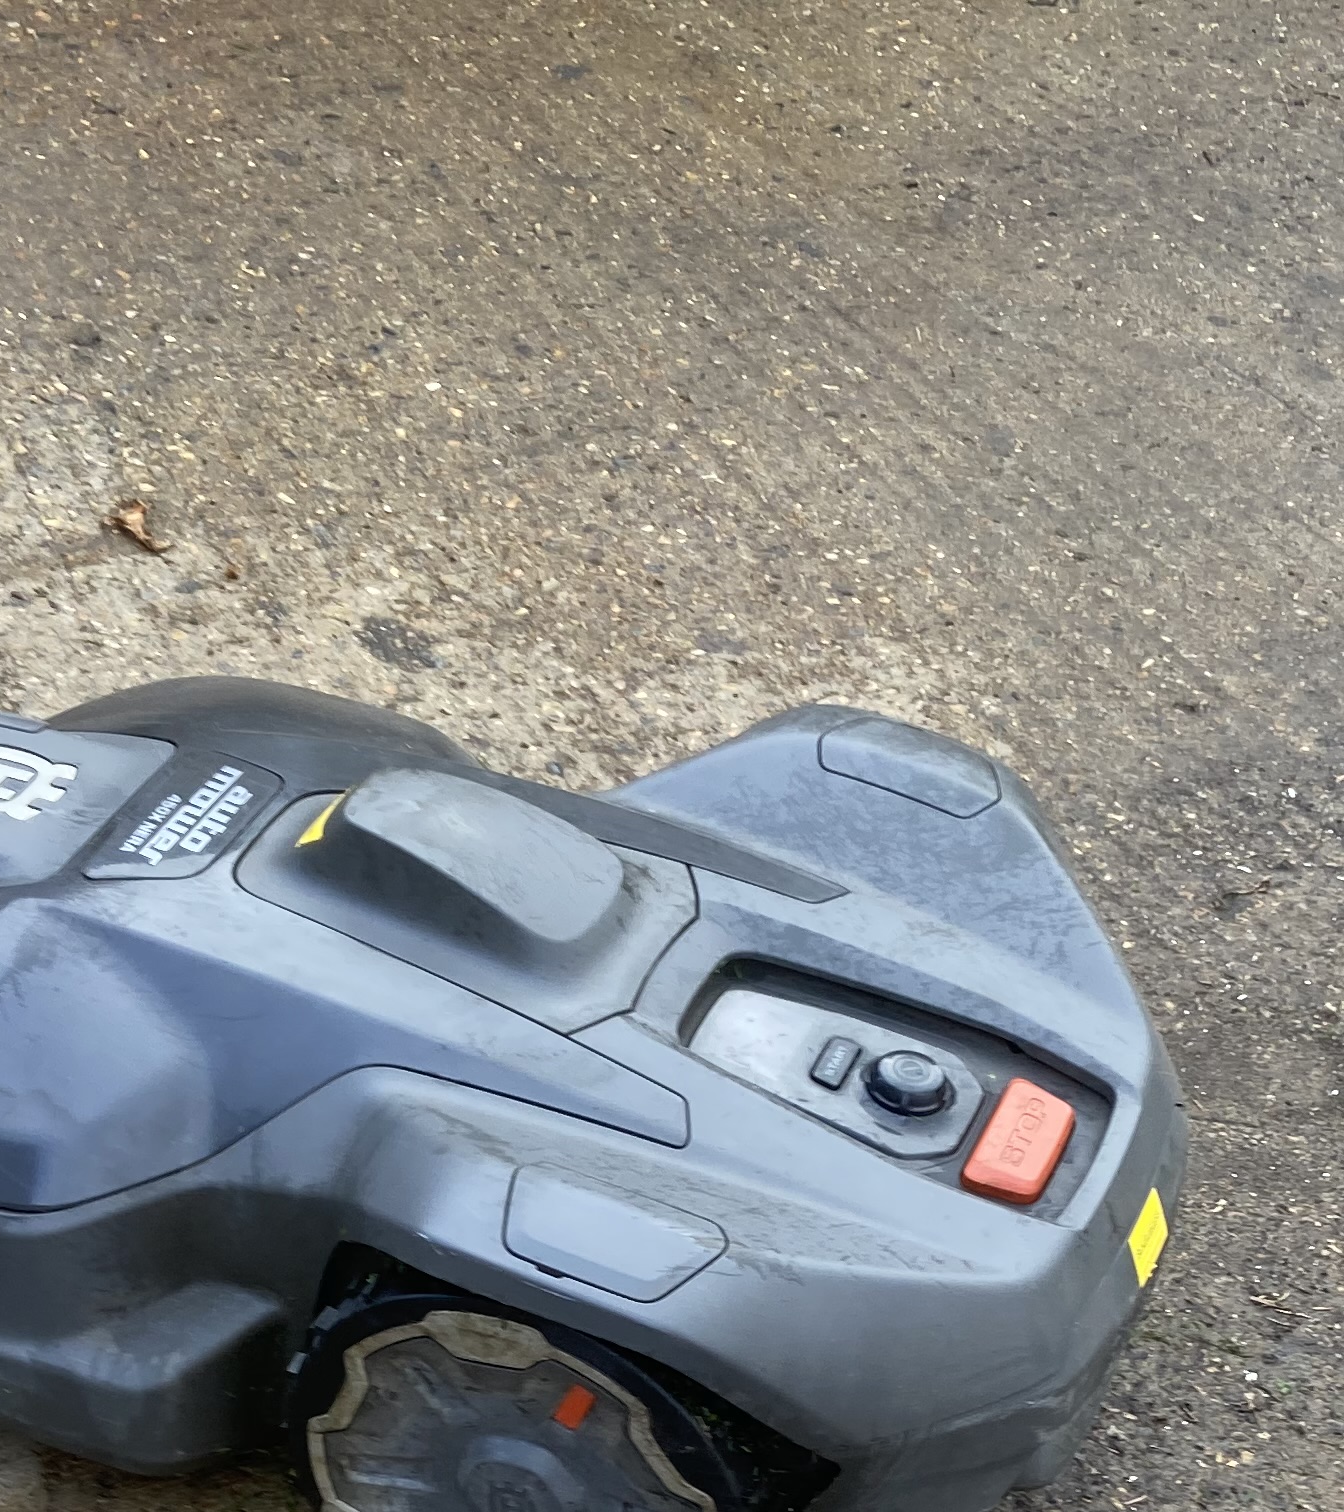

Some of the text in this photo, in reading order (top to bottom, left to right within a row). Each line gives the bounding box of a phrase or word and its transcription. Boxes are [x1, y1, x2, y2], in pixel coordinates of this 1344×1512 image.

[139, 765, 244, 866] mower
[179, 785, 254, 853] auto
[1000, 1097, 1047, 1168] STOP
